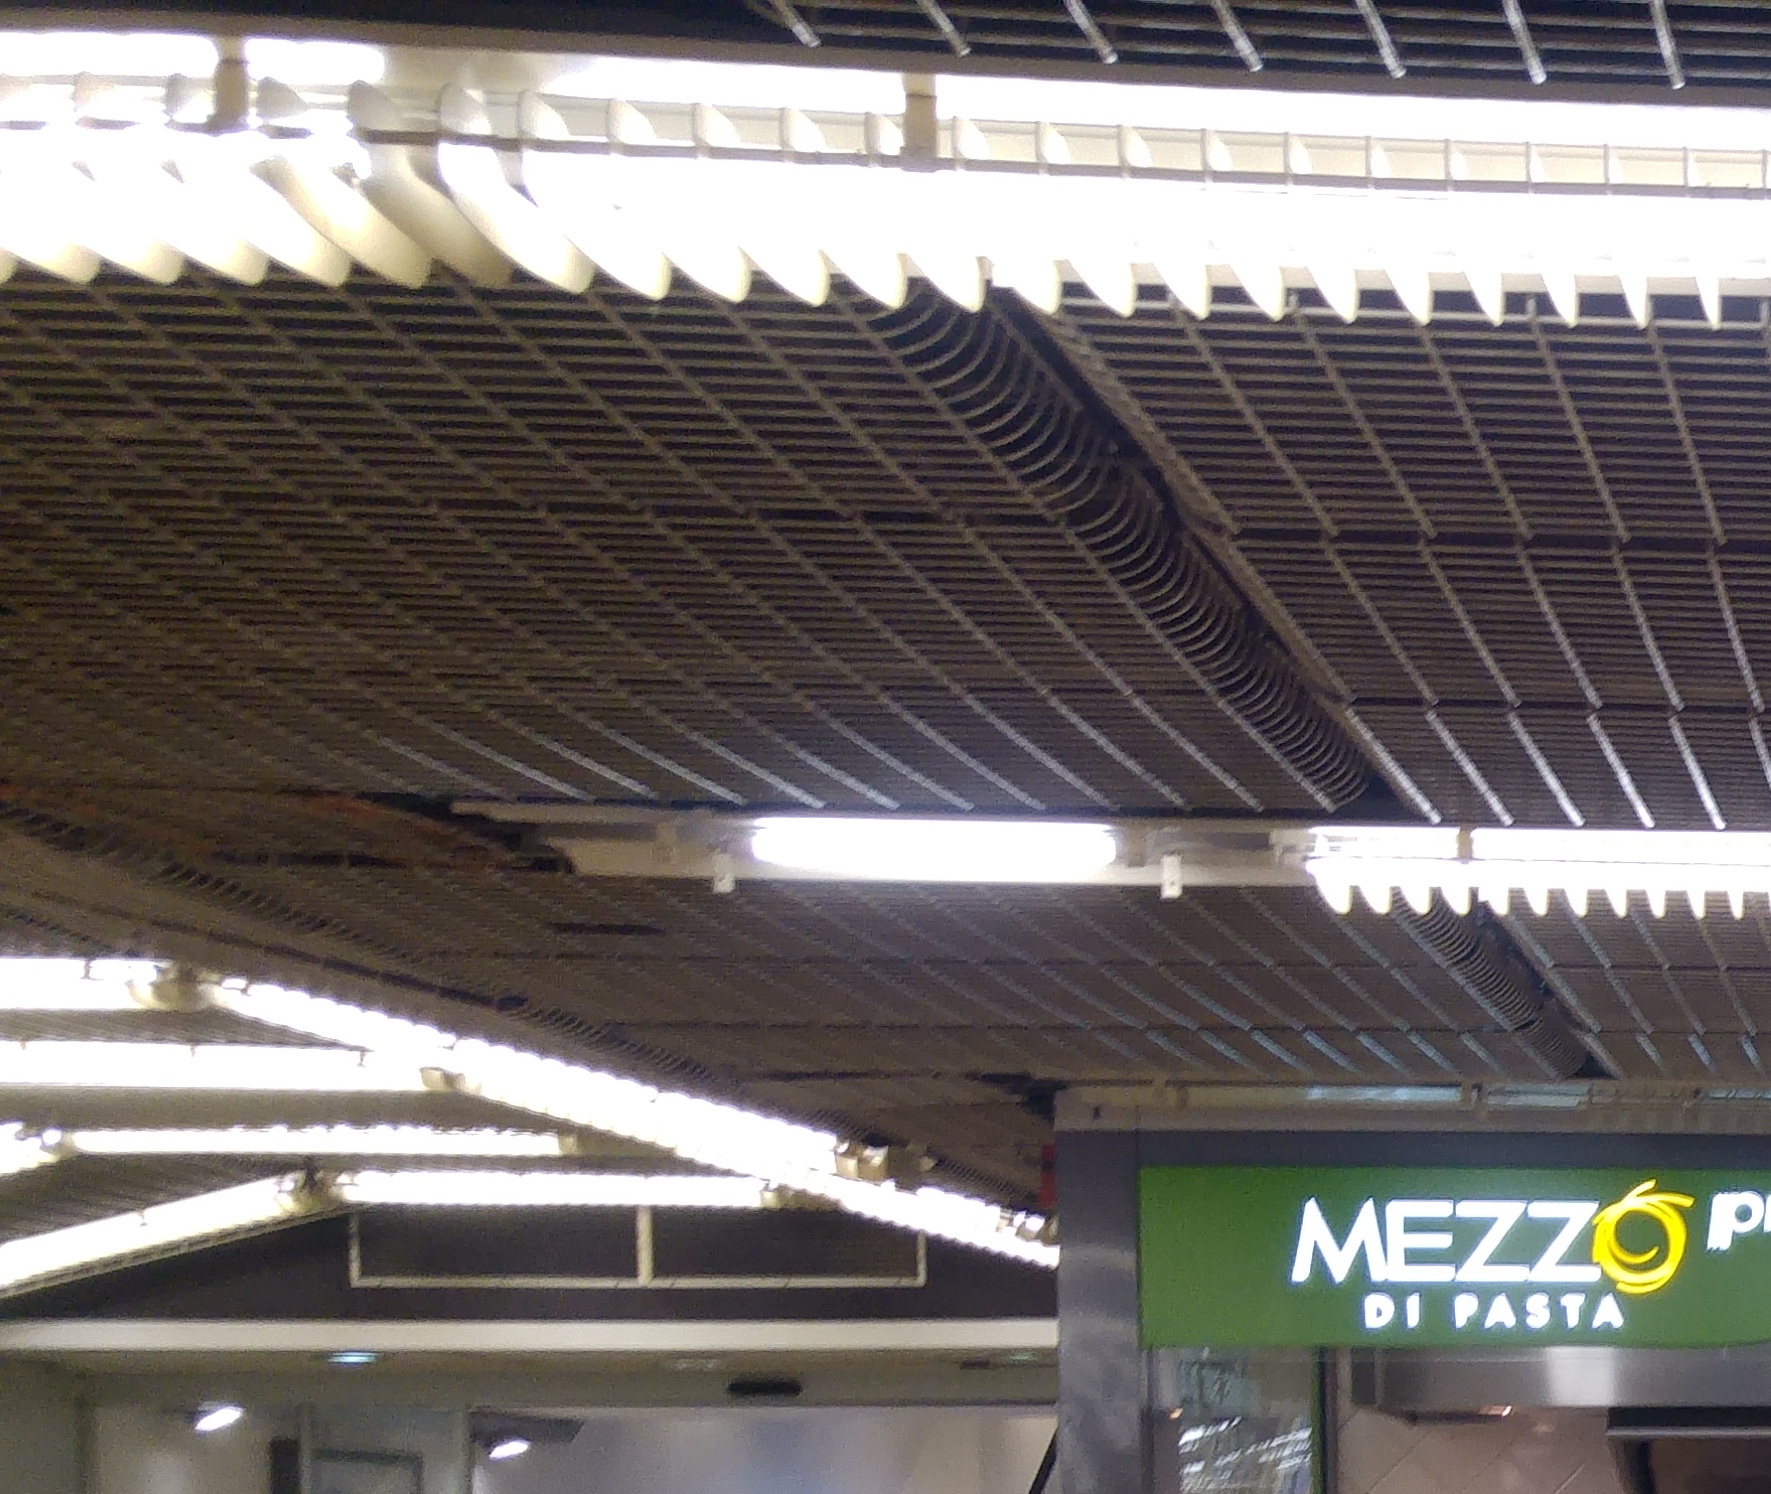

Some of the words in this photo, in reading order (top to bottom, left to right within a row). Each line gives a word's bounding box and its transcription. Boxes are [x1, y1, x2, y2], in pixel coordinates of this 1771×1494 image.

[1291, 1180, 1693, 1294] MEZZO
[1364, 1294, 1420, 1329] DI
[1455, 1294, 1624, 1329] PASTA
